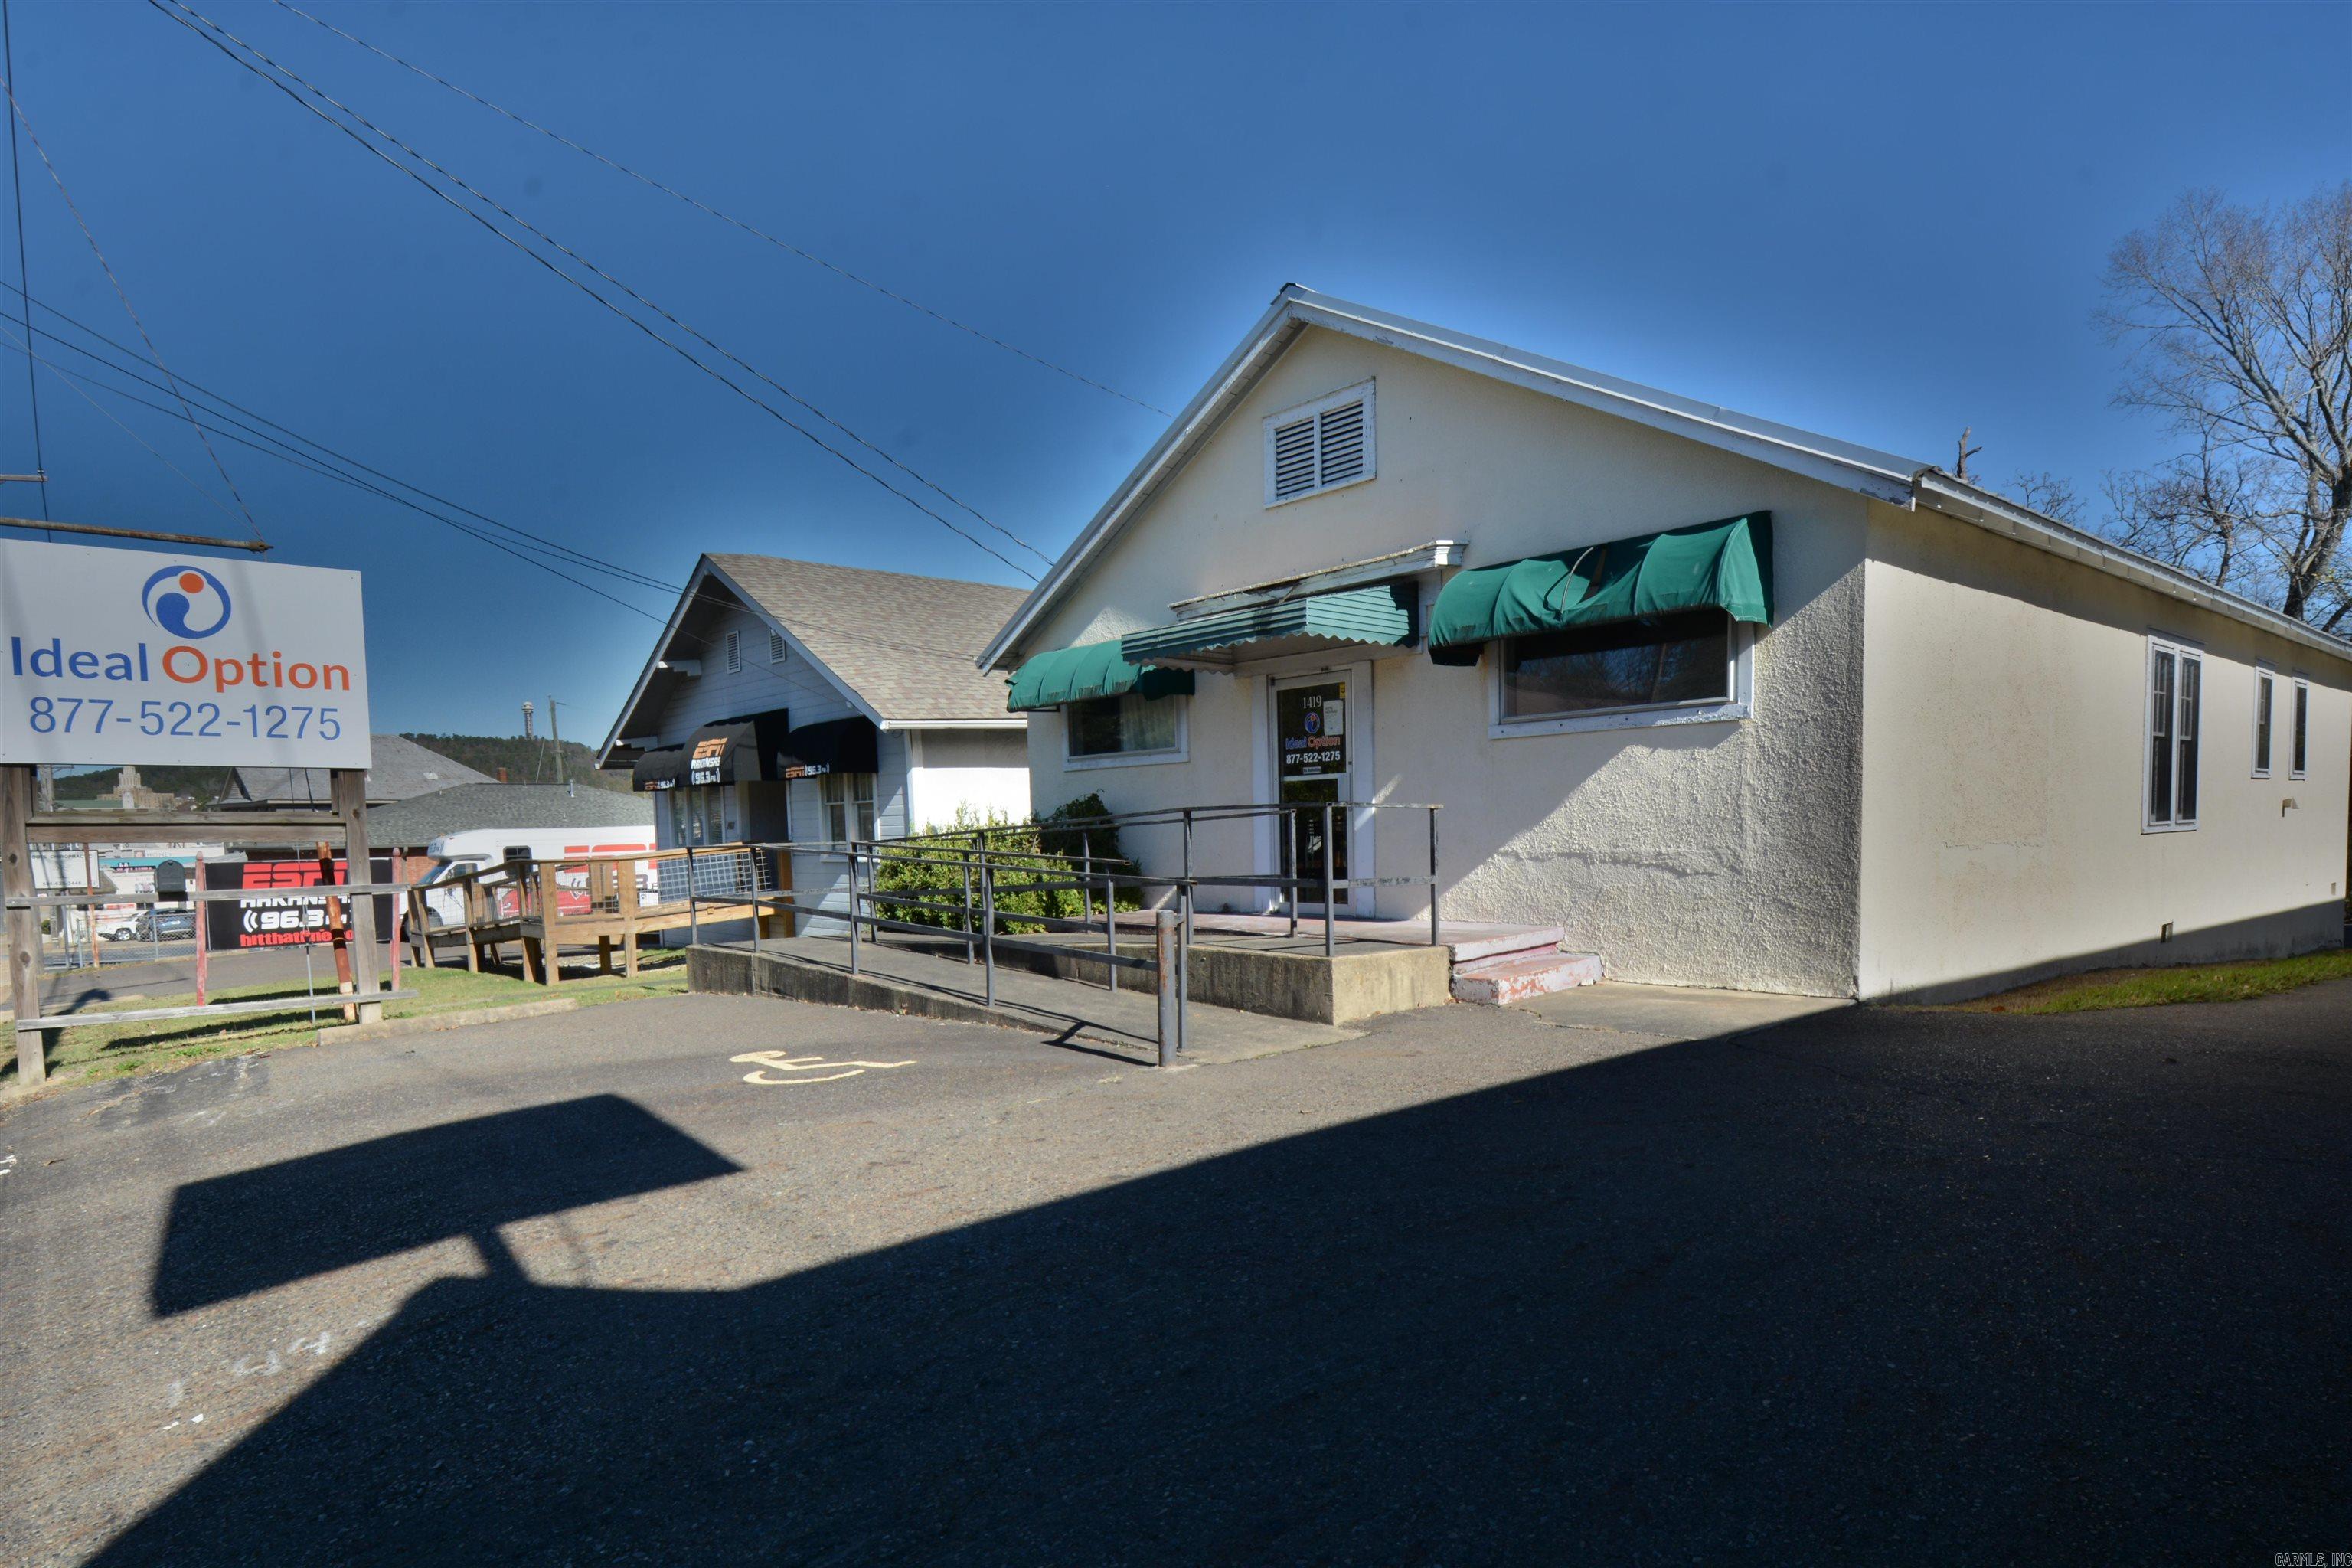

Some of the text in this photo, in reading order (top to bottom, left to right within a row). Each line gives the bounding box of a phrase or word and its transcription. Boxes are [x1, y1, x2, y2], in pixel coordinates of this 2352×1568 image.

[11, 635, 351, 694] Ideal Option
[1303, 694, 1322, 709] 1419
[29, 696, 341, 741] 877-522-1275
[1285, 735, 1341, 750] Ideal Option
[1286, 750, 1341, 764] 877-522-1275
